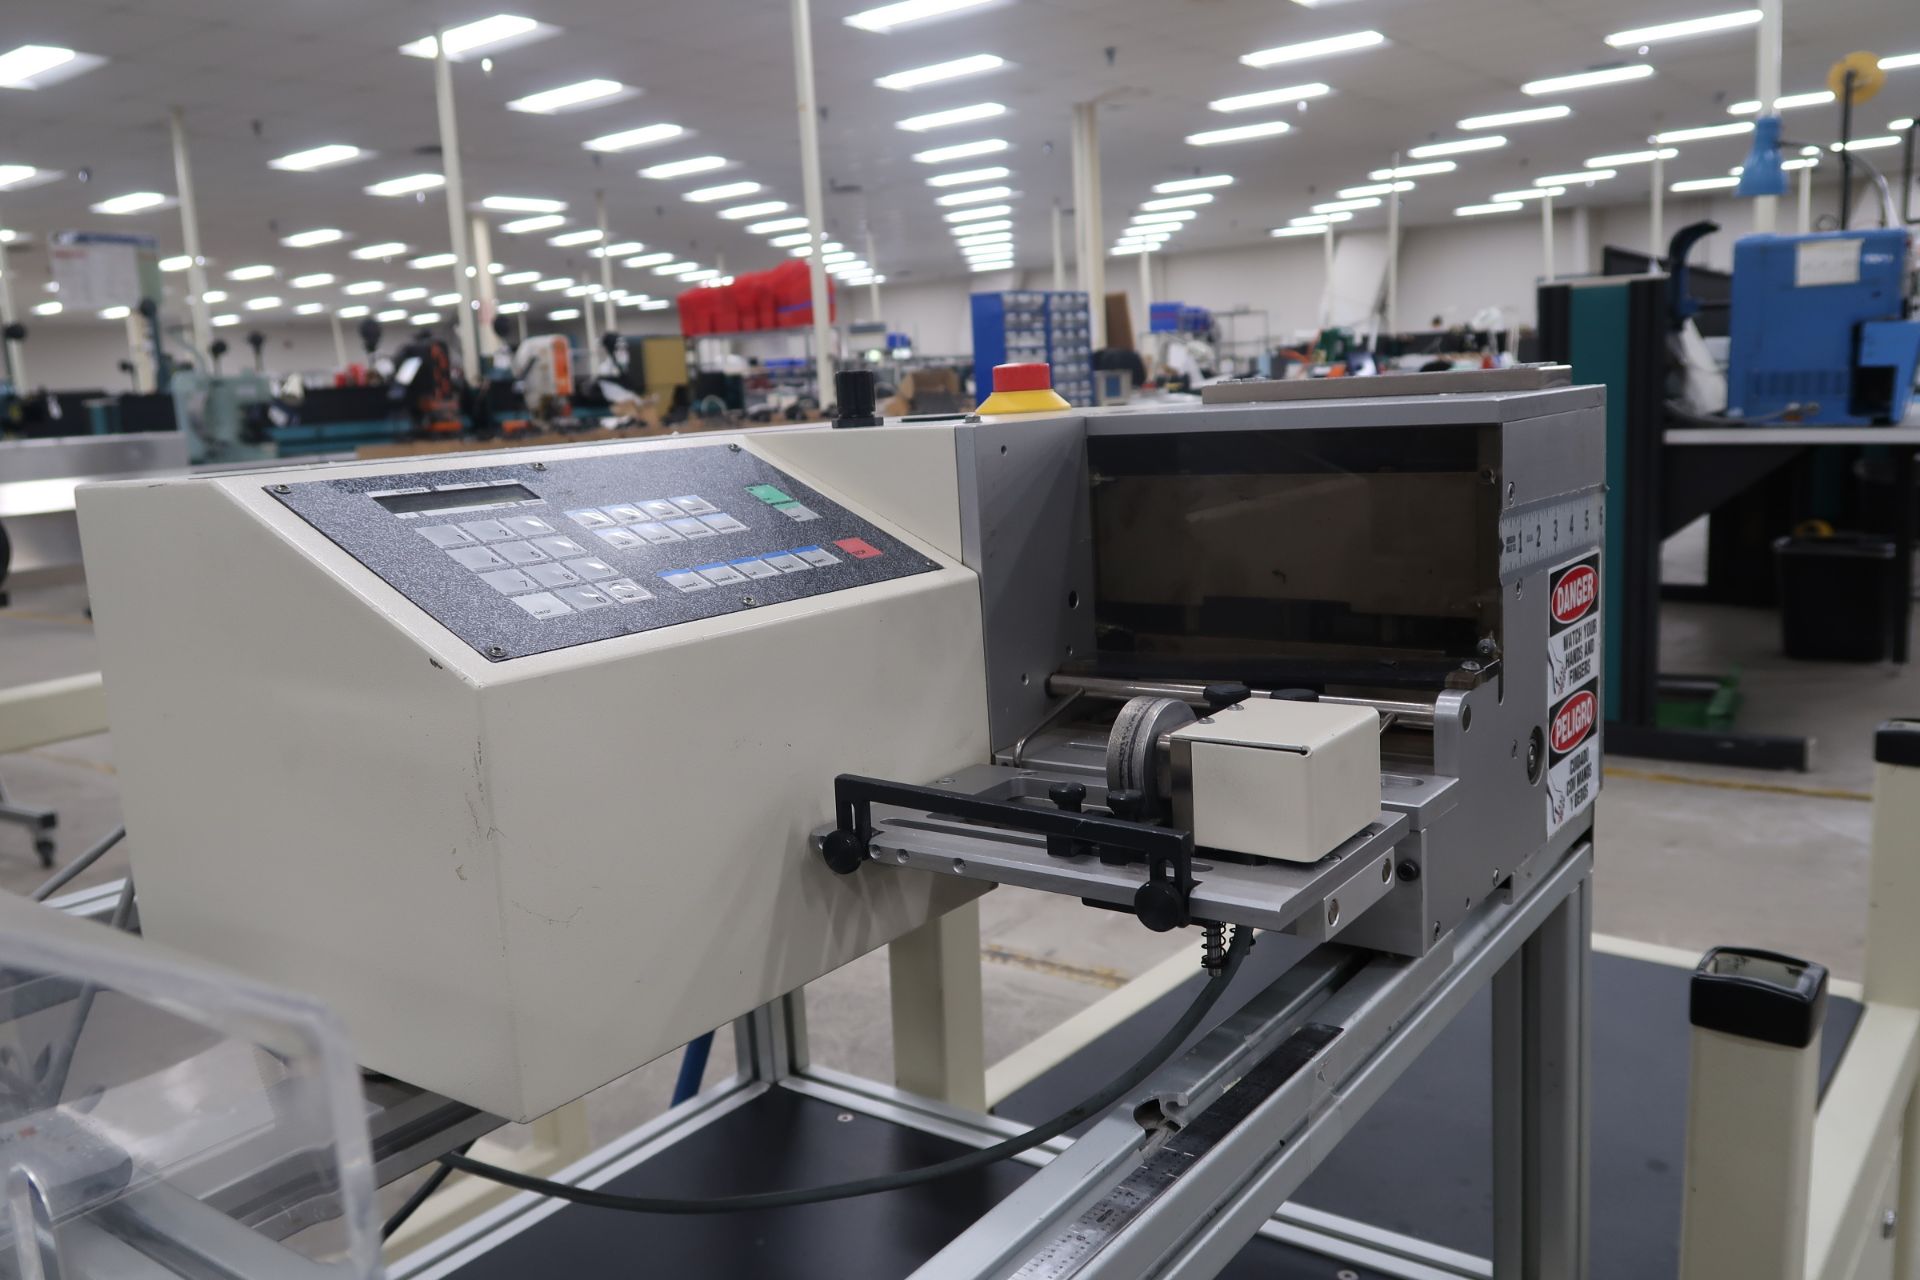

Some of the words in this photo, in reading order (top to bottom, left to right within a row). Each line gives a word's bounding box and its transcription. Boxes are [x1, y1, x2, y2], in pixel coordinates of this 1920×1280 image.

[499, 529, 509, 537] 2
[1517, 529, 1523, 554] 1
[1536, 524, 1542, 548] 2
[1552, 518, 1559, 542] 3
[1569, 513, 1575, 537] 4
[1584, 509, 1590, 532] 5
[490, 556, 500, 564] 4
[530, 550, 542, 559] 5
[562, 573, 574, 581] 8
[1556, 571, 1594, 617] DANGER
[1563, 625, 1582, 652] WATCH
[1583, 617, 1598, 641] YOUR
[1565, 645, 1583, 669] HANDS
[1584, 637, 1595, 658] AND
[1568, 658, 1591, 687] FINGERS
[1555, 697, 1592, 748] PELIGRO
[1569, 746, 1589, 776] CUIDADO
[1566, 775, 1576, 797] CON
[1576, 761, 1592, 787] MANOS
[1575, 782, 1589, 809] DEDOS
